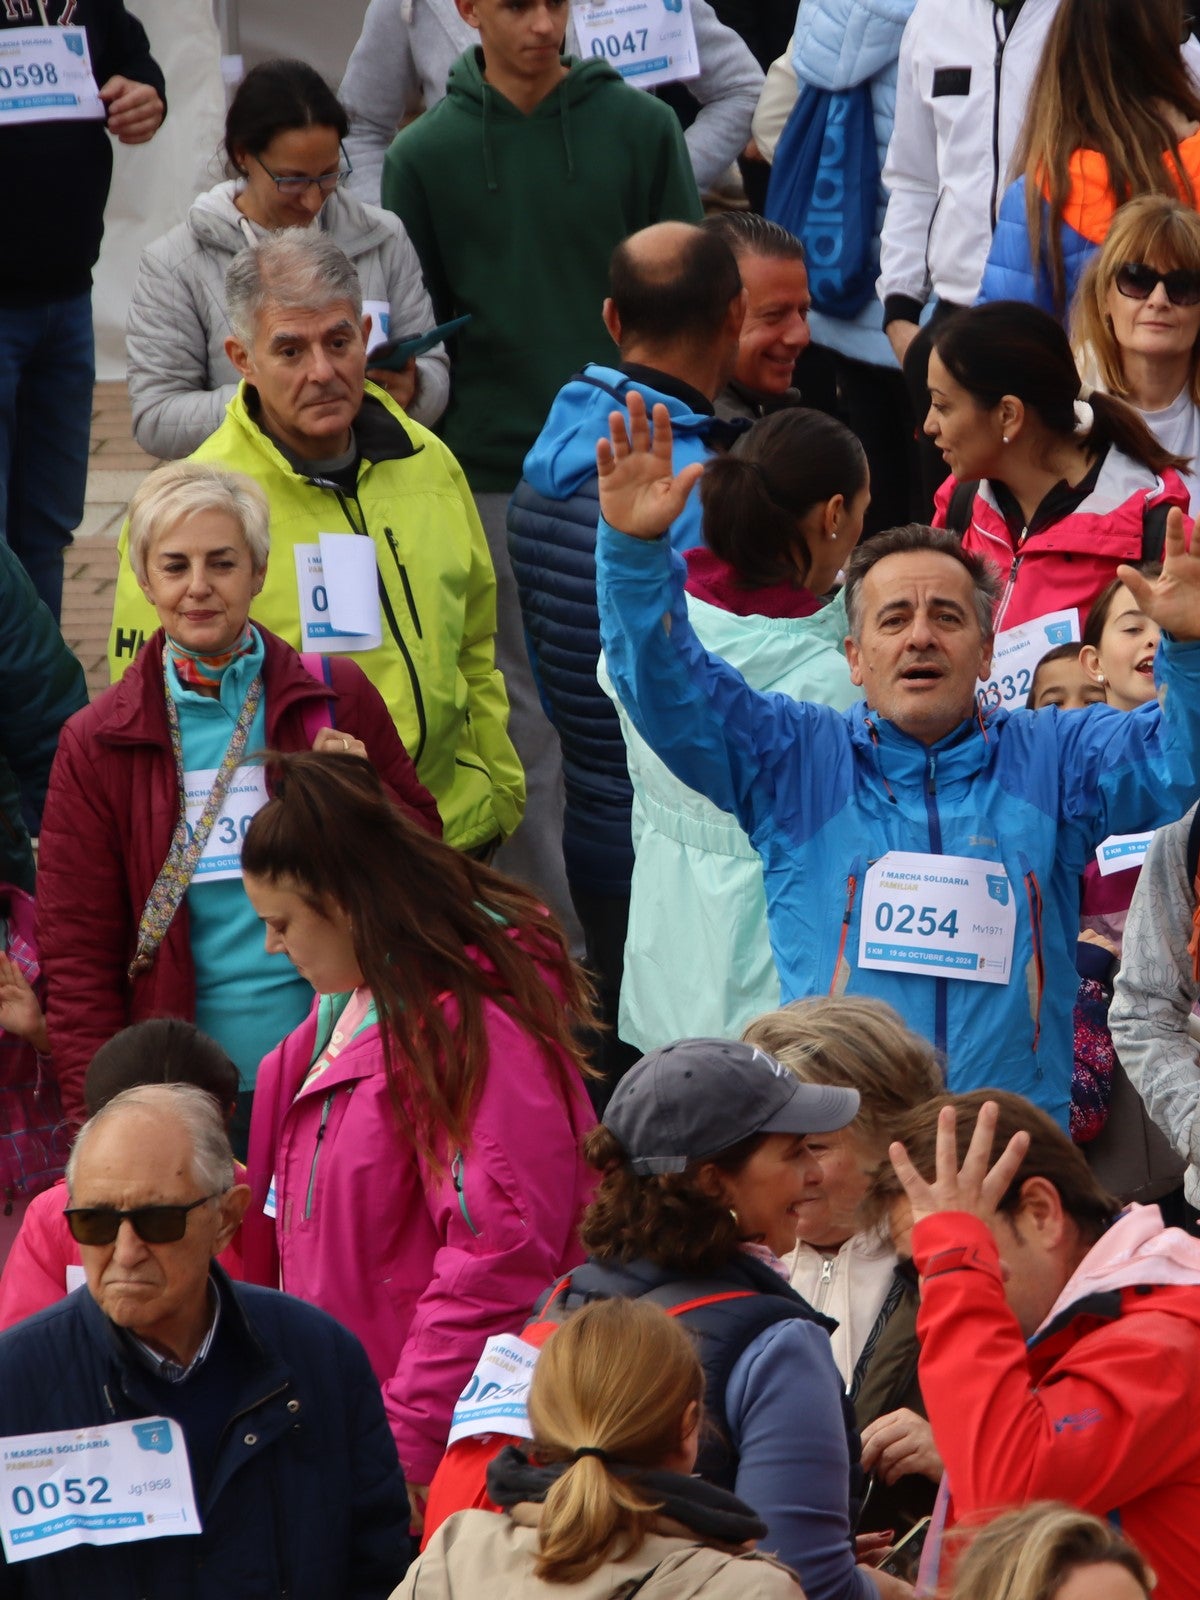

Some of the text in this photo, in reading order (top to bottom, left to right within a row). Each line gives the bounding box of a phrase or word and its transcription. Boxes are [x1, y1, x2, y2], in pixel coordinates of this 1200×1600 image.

[591, 28, 648, 57] 0047
[0, 62, 58, 89] 0598
[977, 668, 1031, 706] 0332
[184, 788, 211, 798] ARCHA
[879, 880, 919, 891] FAMILIAR
[886, 872, 921, 881] MARCHA
[923, 875, 969, 886] SOLIDARIA
[875, 902, 959, 939] 0254
[972, 924, 1003, 936] Mv1971
[867, 947, 883, 956] 5 KM
[898, 950, 907, 958] de
[908, 951, 944, 962] OCTUBRE
[945, 955, 954, 963] de
[955, 956, 972, 965] 2024
[490, 1345, 523, 1364] ARCHA
[10, 1448, 53, 1459] MARCHA
[55, 1439, 110, 1454] SOLIDARIA
[6, 1459, 53, 1471] FAMILIAR
[127, 1478, 172, 1496] Jg1958
[12, 1476, 112, 1515] 0052
[65, 1517, 104, 1529] OCTUBRE
[118, 1515, 137, 1524] 2024
